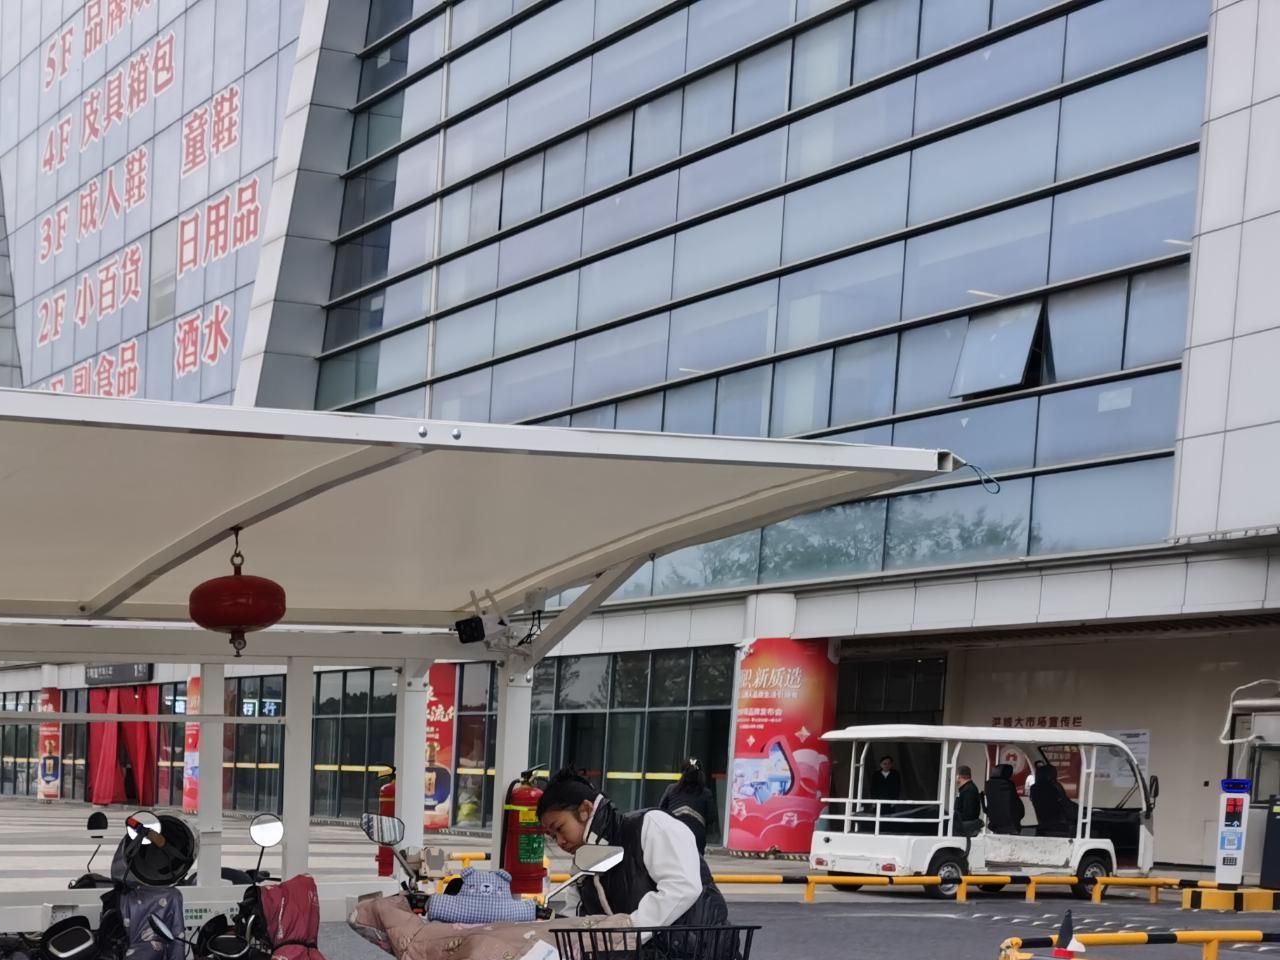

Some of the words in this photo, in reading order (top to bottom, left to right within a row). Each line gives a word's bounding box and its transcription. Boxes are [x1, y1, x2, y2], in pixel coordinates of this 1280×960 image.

[42, 116, 72, 173] 4F
[80, 31, 176, 151] 皮具箱包
[45, 27, 73, 89] 5F
[181, 84, 242, 178] 童鞋
[39, 204, 69, 263] 3F
[78, 147, 149, 241] 成人鞋
[177, 177, 261, 279] 日用品
[37, 290, 67, 345] 2F
[74, 244, 143, 328] 小百货
[175, 302, 231, 377] 酒水
